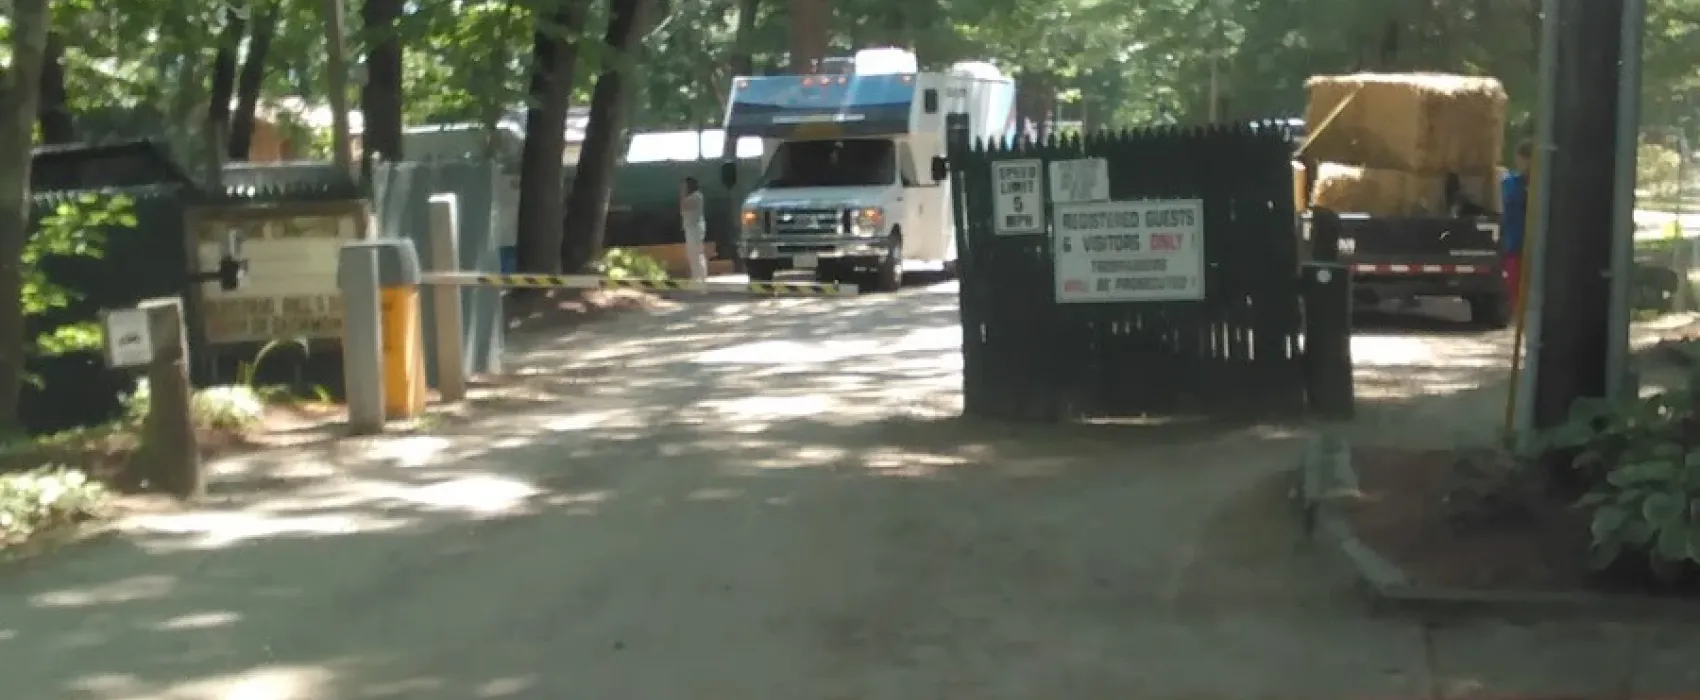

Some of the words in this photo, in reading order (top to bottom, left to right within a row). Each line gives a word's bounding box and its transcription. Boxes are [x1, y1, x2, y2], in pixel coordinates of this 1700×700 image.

[999, 166, 1036, 179] SPEED
[1000, 181, 1034, 195] LIMIT
[1013, 196, 1023, 212] 5
[1006, 215, 1033, 228] MPH
[1062, 212, 1140, 230] REGISTERED
[1146, 209, 1195, 228] GUESTS
[1083, 234, 1140, 253] VISITORS
[1149, 232, 1184, 251] ONLY
